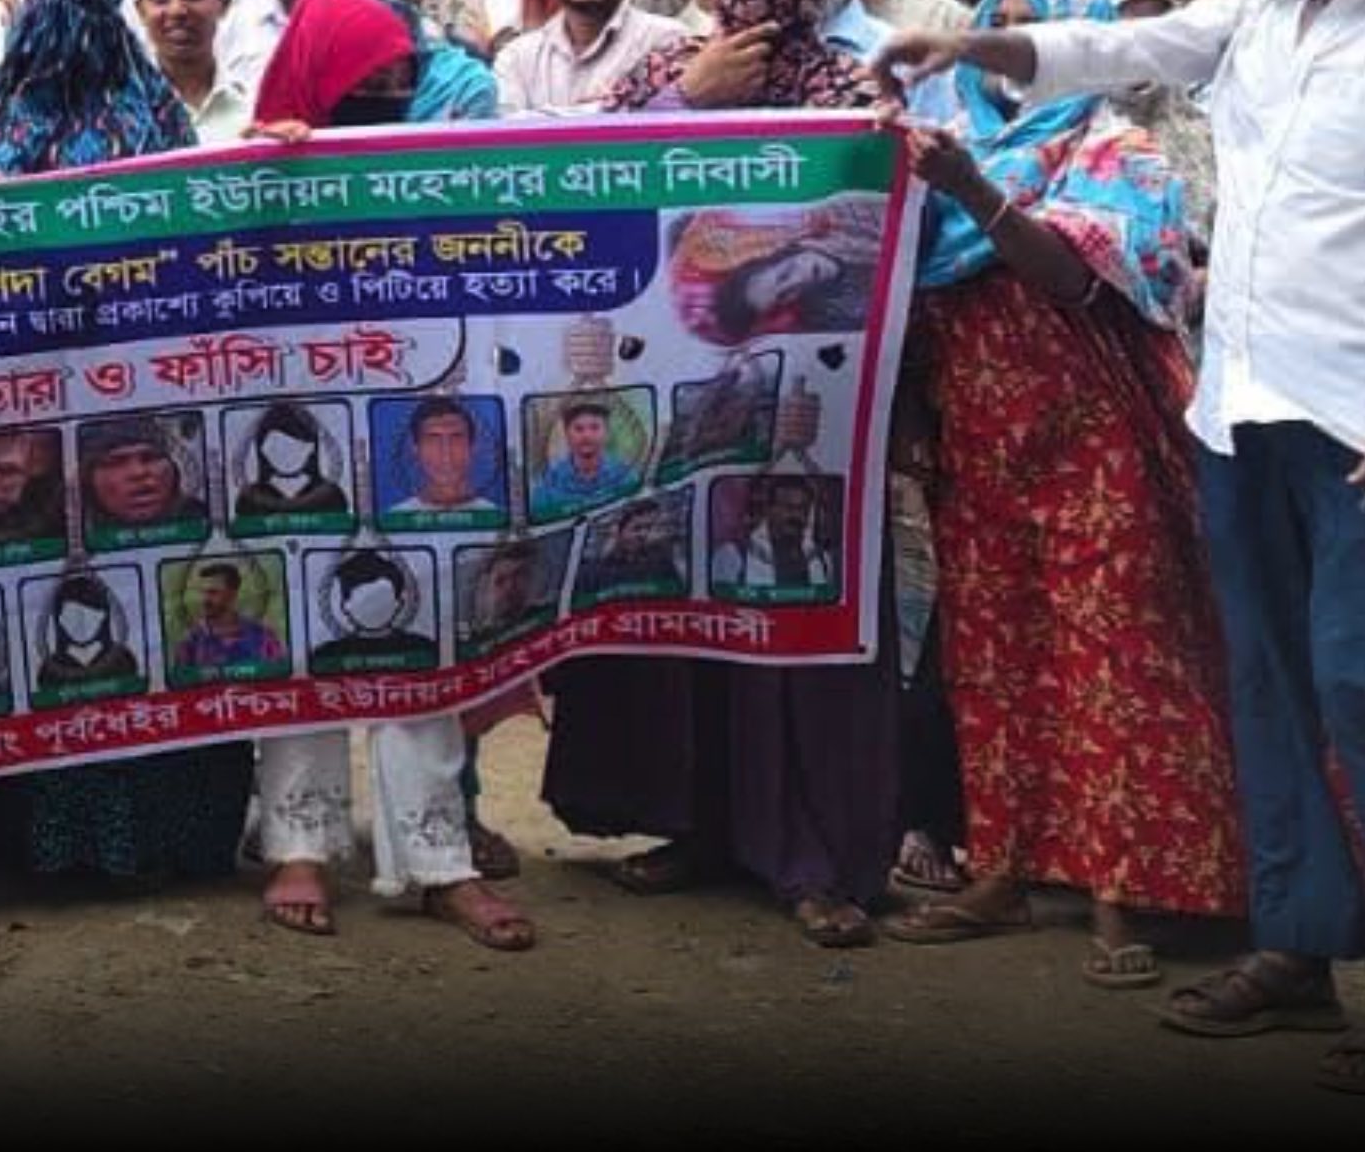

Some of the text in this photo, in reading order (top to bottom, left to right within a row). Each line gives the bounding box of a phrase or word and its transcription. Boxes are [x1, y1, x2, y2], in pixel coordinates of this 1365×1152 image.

[56, 183, 171, 229] পশ্চিম
[186, 169, 352, 219] ইউনিয়ন
[368, 163, 546, 206] মহেশপুর
[559, 156, 647, 197] গ্রাম
[662, 144, 806, 191] নিবাসী
[195, 238, 262, 280] পাঁচ
[430, 219, 588, 264] জননীকে
[211, 280, 302, 320] কুপিয়ে
[315, 280, 339, 304] ও
[353, 270, 449, 305] পিটিয়ে
[463, 269, 539, 303] হত্যা
[83, 361, 136, 396] ও
[149, 332, 277, 393] ফাঁসি
[300, 326, 409, 382] চাই
[195, 686, 300, 725] পশ্চিম
[315, 674, 463, 713] ইউনিয়ন
[612, 607, 776, 644] গ্রামবাসী
